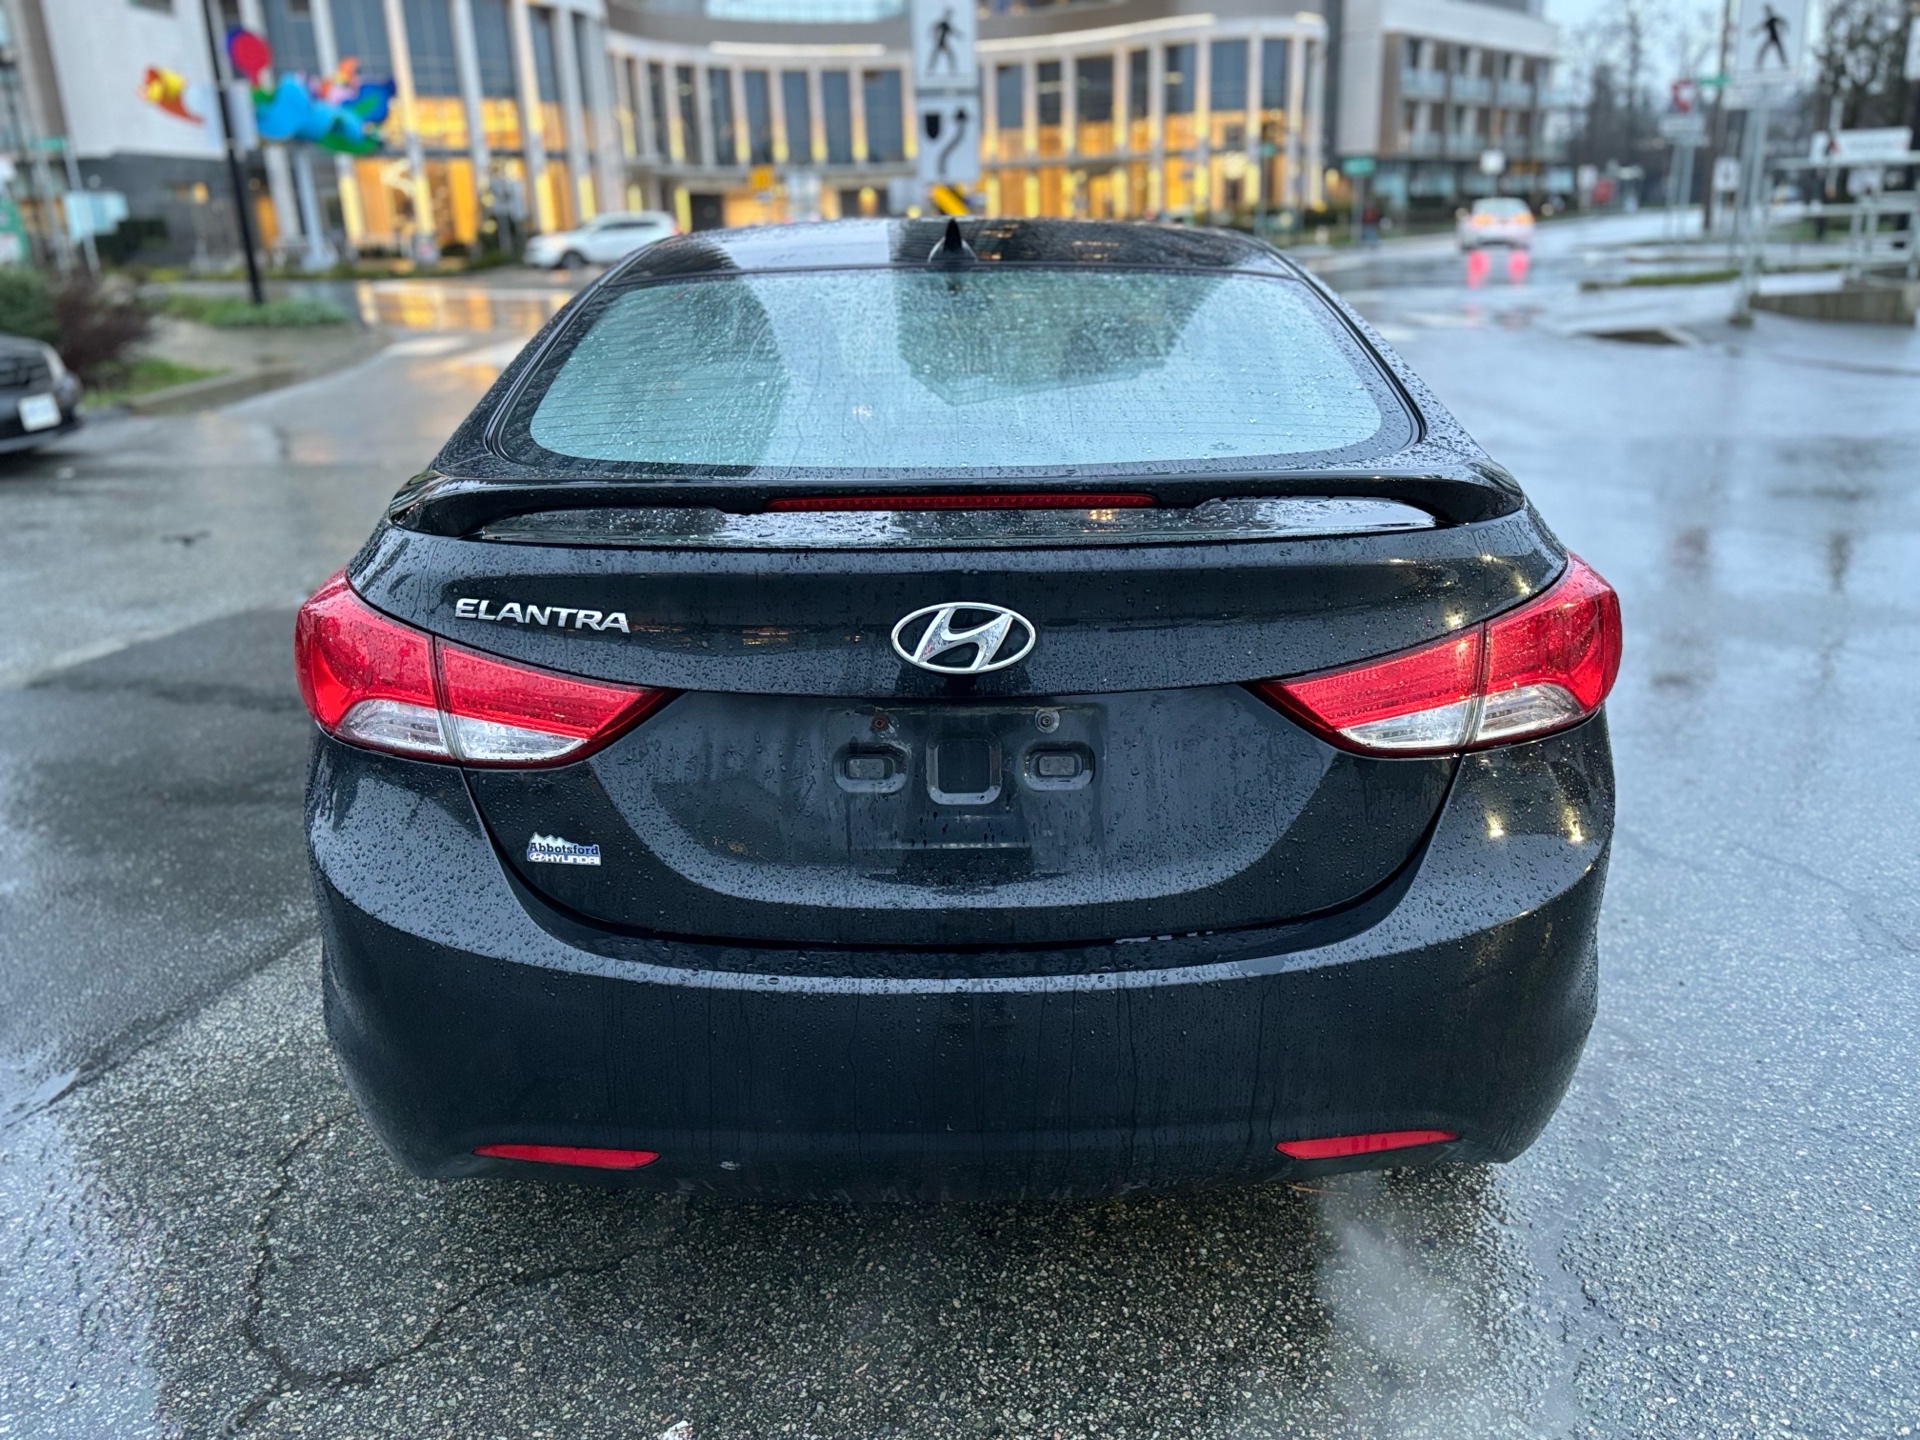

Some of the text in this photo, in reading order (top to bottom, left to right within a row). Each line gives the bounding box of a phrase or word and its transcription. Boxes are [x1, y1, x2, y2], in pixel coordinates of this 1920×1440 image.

[455, 598, 630, 633] ELANTRA
[529, 842, 599, 855] Abbotsford
[545, 853, 600, 865] HYUNDAI
